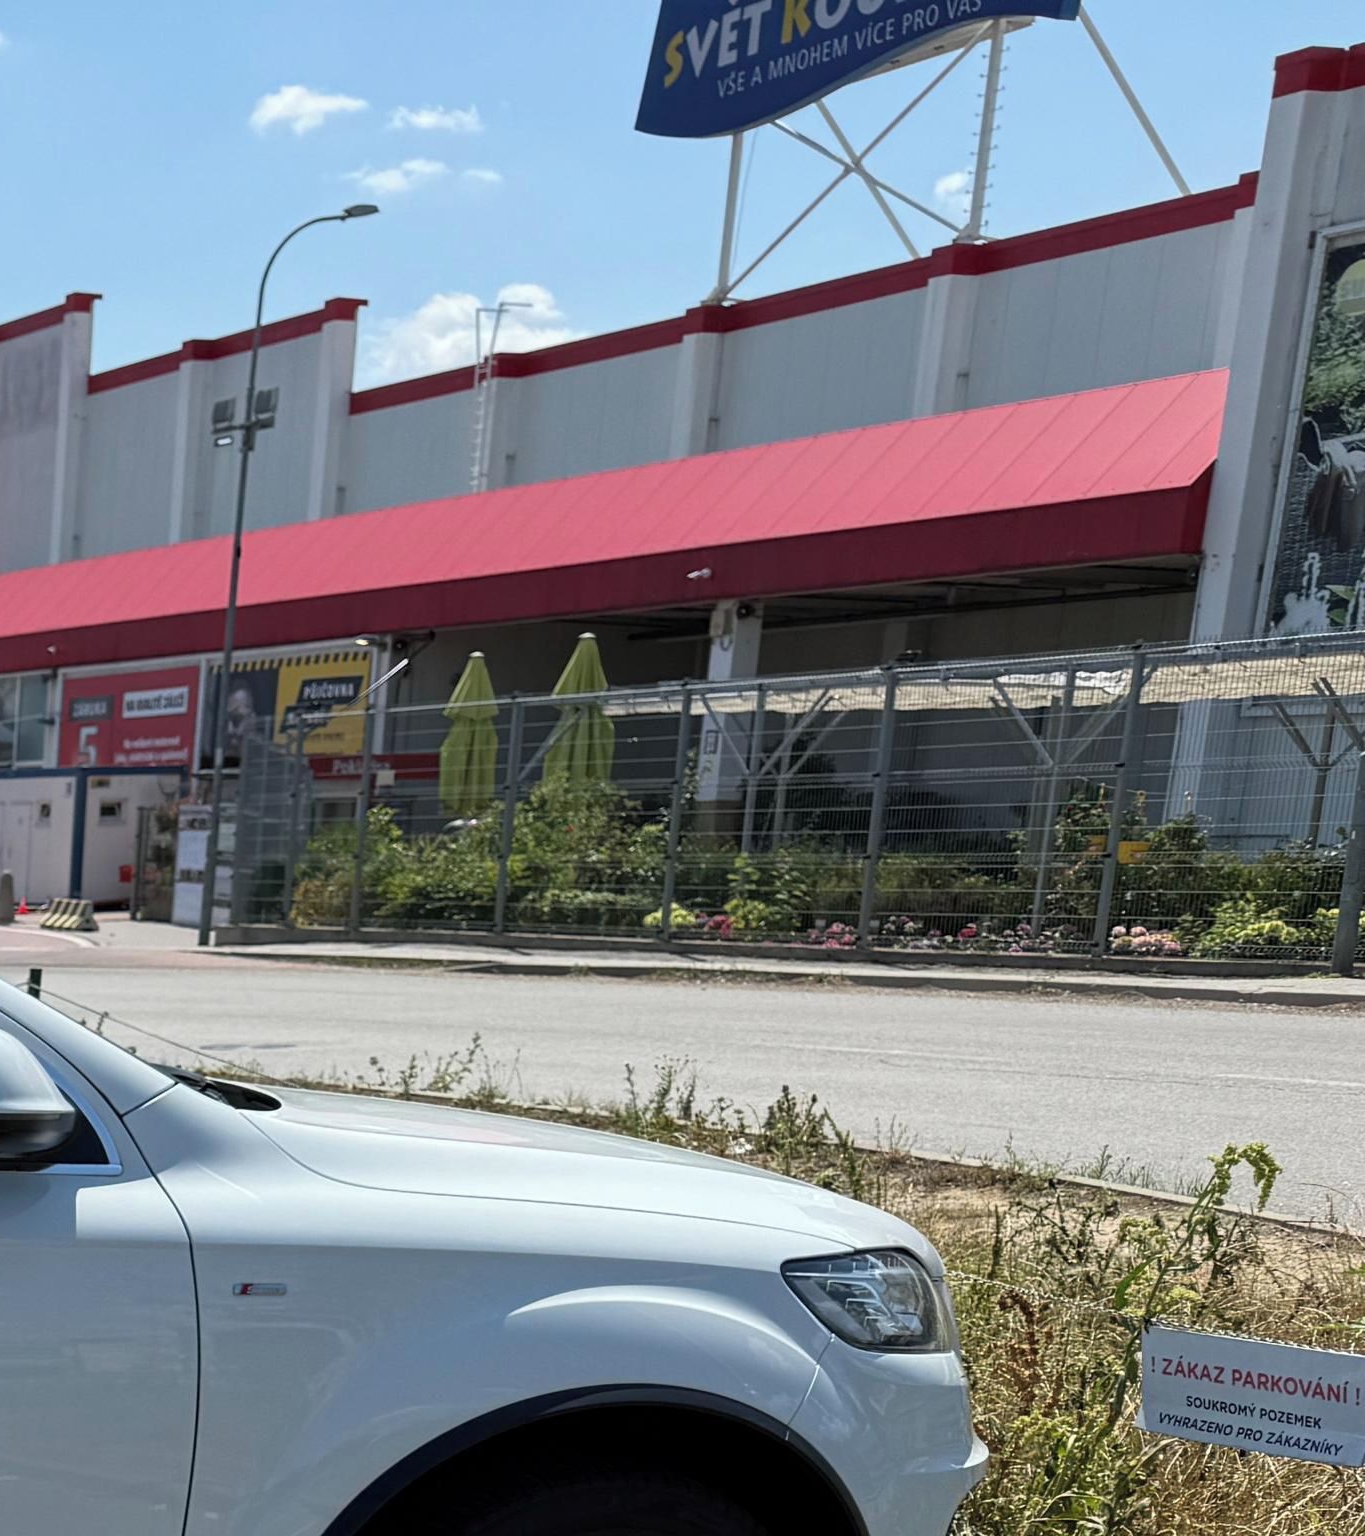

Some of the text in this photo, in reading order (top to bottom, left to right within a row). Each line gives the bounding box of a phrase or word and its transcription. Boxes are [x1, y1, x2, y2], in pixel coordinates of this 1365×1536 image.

[717, 70, 746, 98] VŠE
[750, 66, 762, 87] A
[768, 35, 848, 80] MNOHEM
[855, 18, 895, 50] VÍCE
[902, 4, 939, 35] PRO
[1161, 1355, 1225, 1384] ZÁKAZ
[1231, 1368, 1349, 1404] PARKOVÁNÍ
[1158, 1412, 1344, 1456] VYHRAZENO PRO ZÁKAZNÍKY
[1185, 1395, 1322, 1429] SOUKROMÝ POZEMEK
